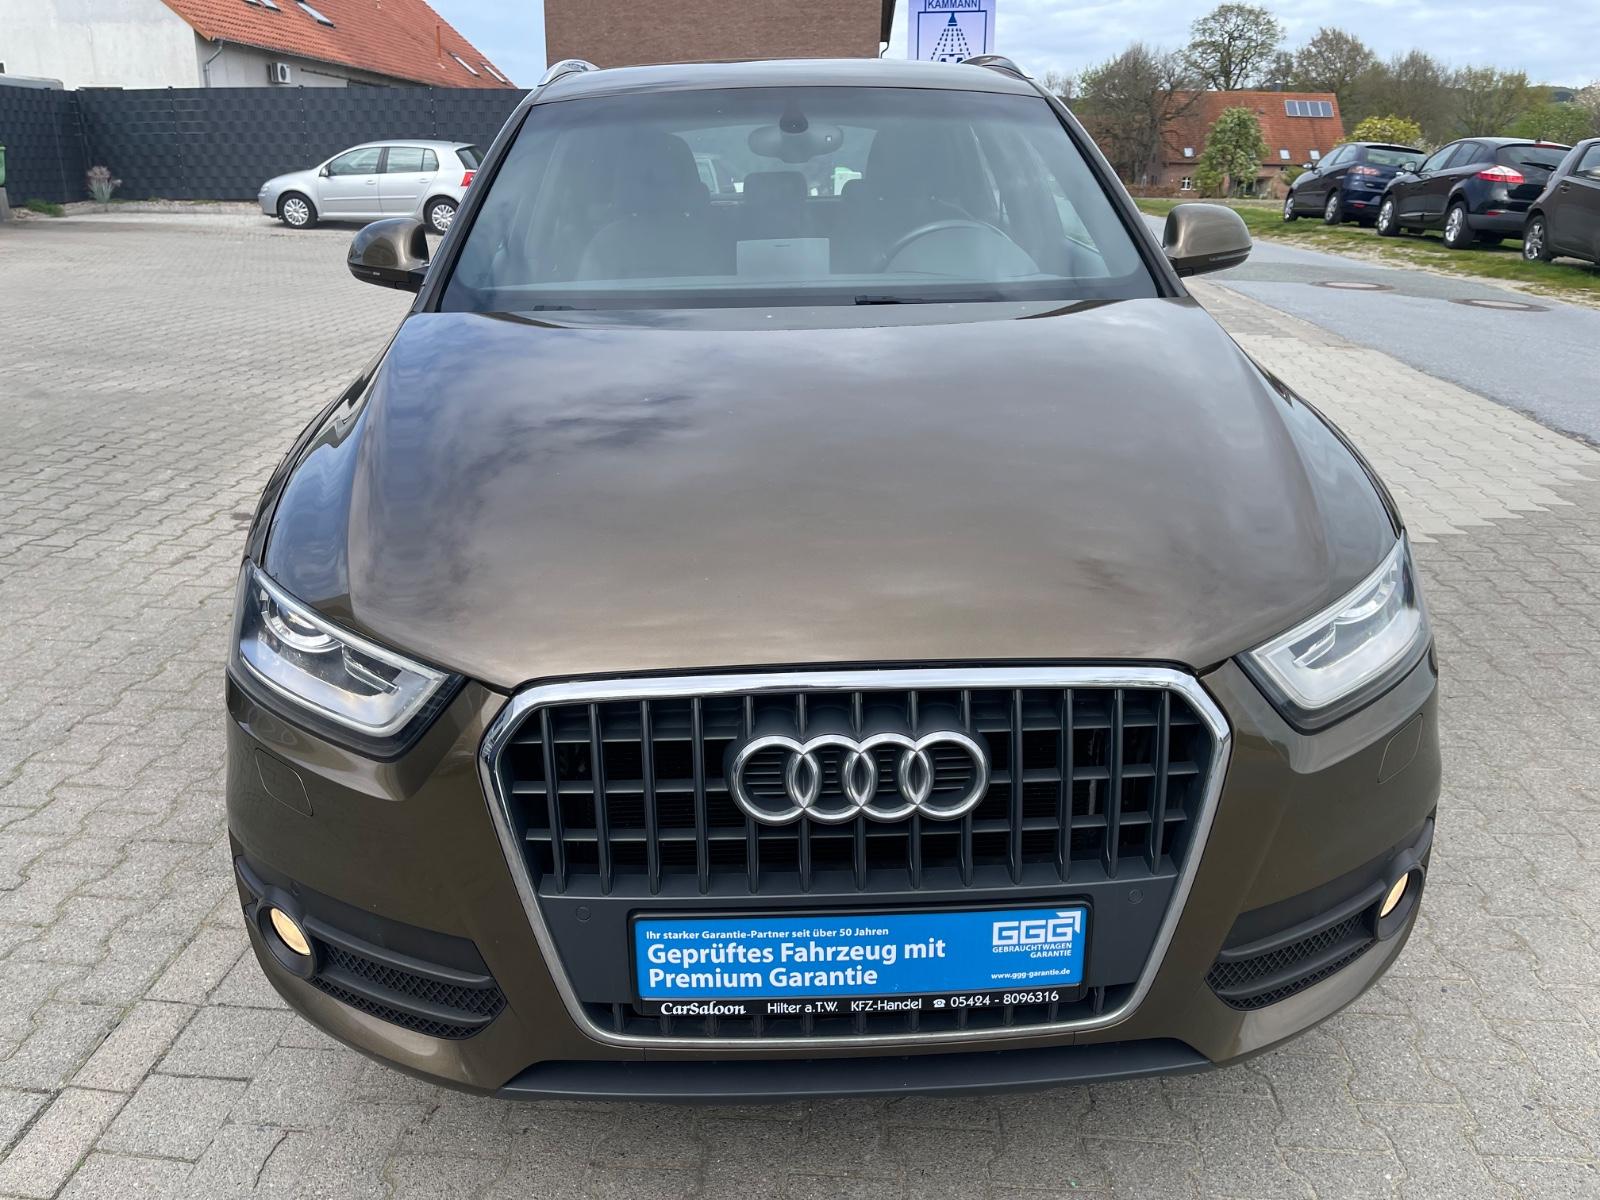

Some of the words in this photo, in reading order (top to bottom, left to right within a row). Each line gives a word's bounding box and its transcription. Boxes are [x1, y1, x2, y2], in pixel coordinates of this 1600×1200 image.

[928, 0, 977, 8] KAMMANN
[646, 931, 661, 940] Ihr
[663, 931, 699, 940] starker
[702, 929, 789, 939] Garantie-Partner
[792, 928, 810, 938] seit
[813, 928, 836, 938] über
[839, 928, 852, 937] 50
[854, 927, 889, 936] Jahren
[992, 915, 1074, 946] GGG
[647, 943, 774, 969] Geprüftes
[780, 940, 897, 966] Fahrzeug
[904, 937, 946, 960] mit
[992, 942, 1072, 953] GEBRAUCHTWAGEN
[1030, 949, 1072, 958] GARANTIE
[649, 968, 762, 988] Premium
[769, 965, 878, 988] Garantie
[991, 968, 1071, 980] www.ggg-garantie.de
[660, 1001, 747, 1015] CarSaloon
[767, 1001, 801, 1014] Hilter
[851, 998, 922, 1012] KFZ-Handel
[950, 996, 990, 1008] 05424
[1003, 991, 1059, 1005] 8096316
